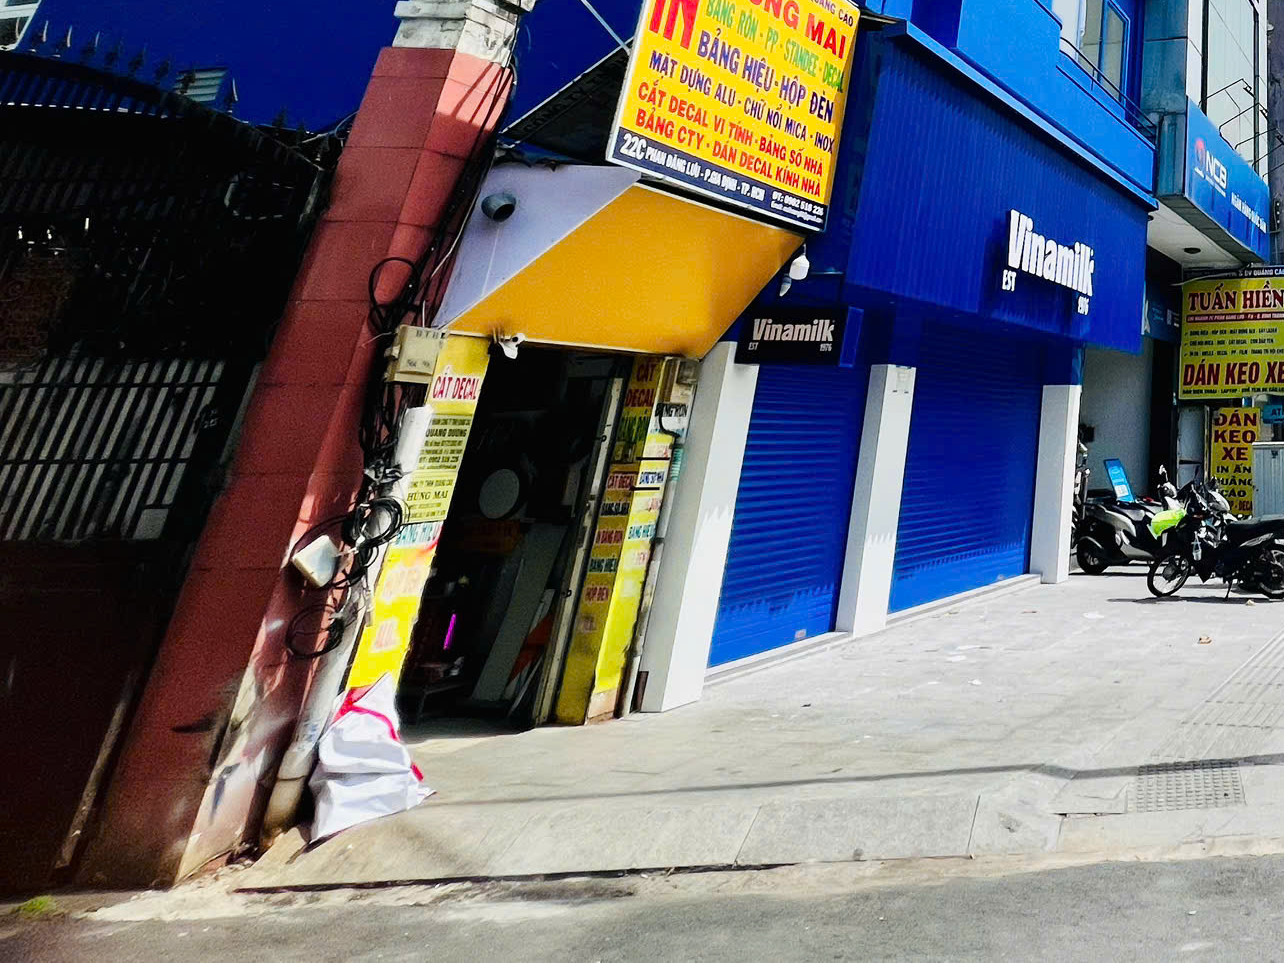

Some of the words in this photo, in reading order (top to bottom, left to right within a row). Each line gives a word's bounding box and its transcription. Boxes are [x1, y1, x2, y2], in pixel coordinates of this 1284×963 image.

[805, 12, 846, 60] MAI
[697, 27, 741, 75] BẢNG
[742, 54, 775, 93] HIỆU
[780, 75, 806, 110] HỘP
[649, 50, 678, 79] MẶT
[714, 83, 736, 107] ALU
[784, 116, 807, 141] MICA
[814, 131, 836, 154] INOX
[668, 95, 709, 128] DECAL
[713, 114, 726, 135] VI
[728, 120, 754, 147] TÍNH
[759, 133, 787, 162] BẢNG
[620, 132, 647, 161] 22C
[635, 106, 675, 140] BẢNG
[677, 125, 705, 150] CTY
[712, 140, 738, 165] DÁN
[740, 151, 773, 179] DECAL
[775, 165, 800, 189] KÍNH
[1205, 149, 1228, 190] NCB
[1008, 208, 1093, 297] Vinamilk
[1001, 268, 1018, 292] EST
[1187, 282, 1238, 312] TUẤN
[752, 318, 836, 342] Vinamilk
[748, 341, 760, 351] EST
[1182, 358, 1222, 387] DÁN
[1224, 360, 1261, 386] KEO
[452, 377, 480, 400] DECAL
[1214, 409, 1258, 427] DÁN
[1213, 429, 1257, 444] KEO
[1221, 446, 1249, 461] XE
[1216, 465, 1230, 474] IN
[433, 490, 450, 500] MAI
